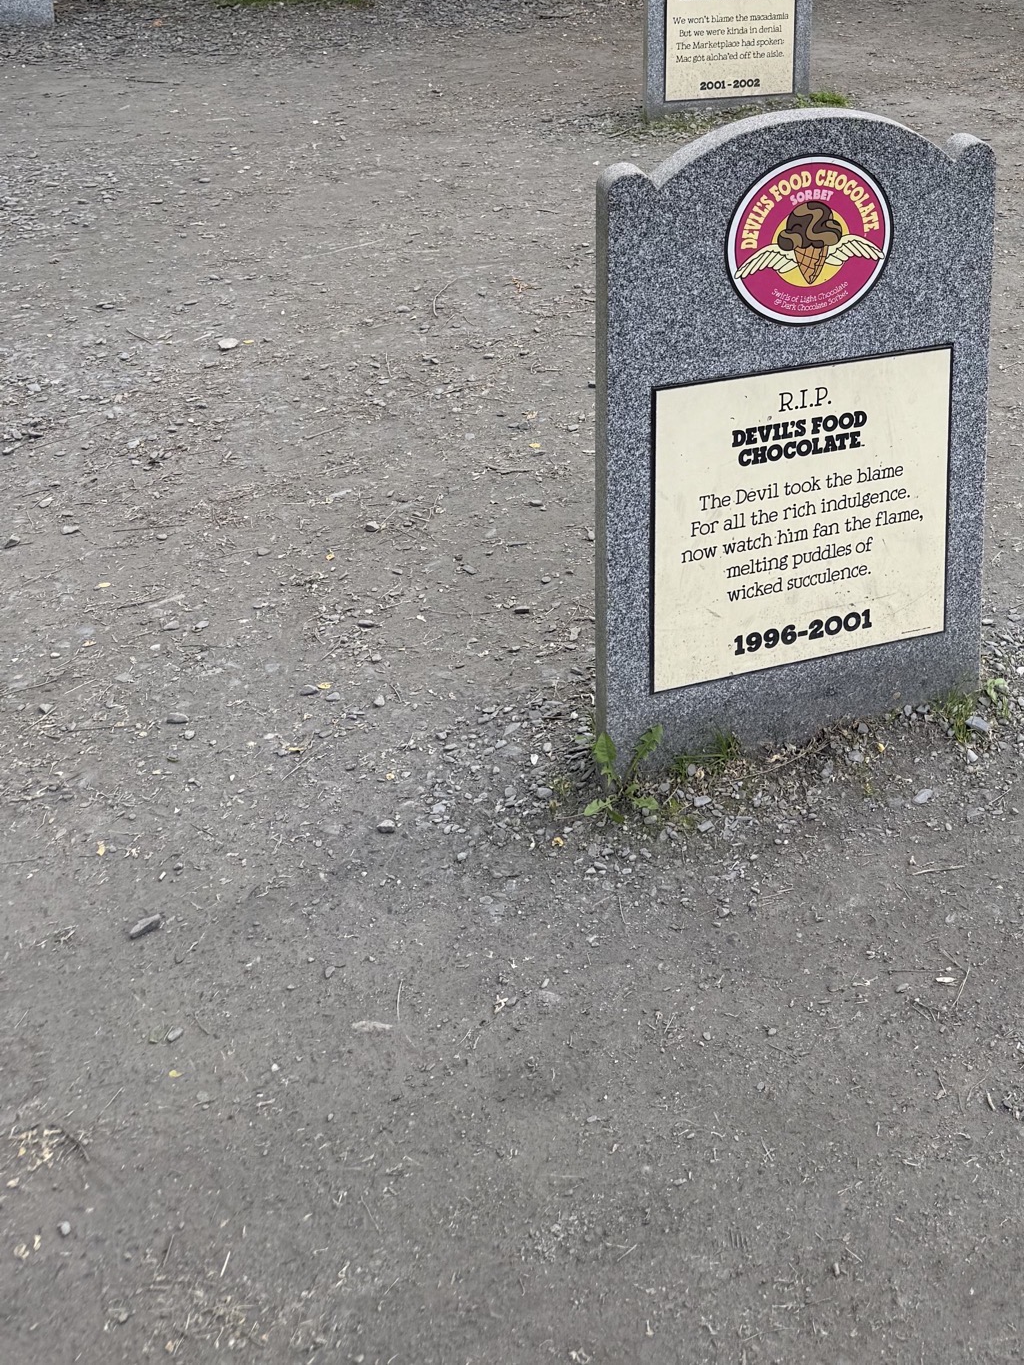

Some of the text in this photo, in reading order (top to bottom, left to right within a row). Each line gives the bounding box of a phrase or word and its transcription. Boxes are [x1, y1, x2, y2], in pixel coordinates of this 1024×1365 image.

[688, 16, 710, 24] won't
[711, 15, 734, 23] blame
[750, 12, 789, 21] macadamia
[727, 27, 747, 35] kinda
[759, 25, 782, 33] denial
[676, 42, 691, 50] The
[693, 40, 740, 49] Marketplace
[757, 38, 784, 47] spoken:
[676, 55, 691, 63] Mac
[693, 55, 705, 63] got
[706, 52, 738, 61] aloha'ed
[741, 169, 880, 249] DEVIL'S FOOD CHOCOLATE
[790, 189, 834, 206] SORBET
[772, 282, 848, 303] Swirls of Light Chocolate
[781, 302, 796, 311] Dark
[797, 302, 827, 311] Chocolate
[828, 290, 848, 305] Sorbet
[779, 387, 832, 412] R.I.P.
[732, 410, 867, 447] DEVIL'S FOOD
[738, 431, 861, 466] CHOCOLATE
[700, 465, 903, 511] The Devil took the blame
[691, 488, 910, 537] For all the rich indulgence.
[681, 508, 924, 563] now watch him fan the flame,
[727, 537, 873, 578] melting puddles of
[727, 564, 871, 602] wicked succulence.
[734, 609, 872, 655] 1996-2001
